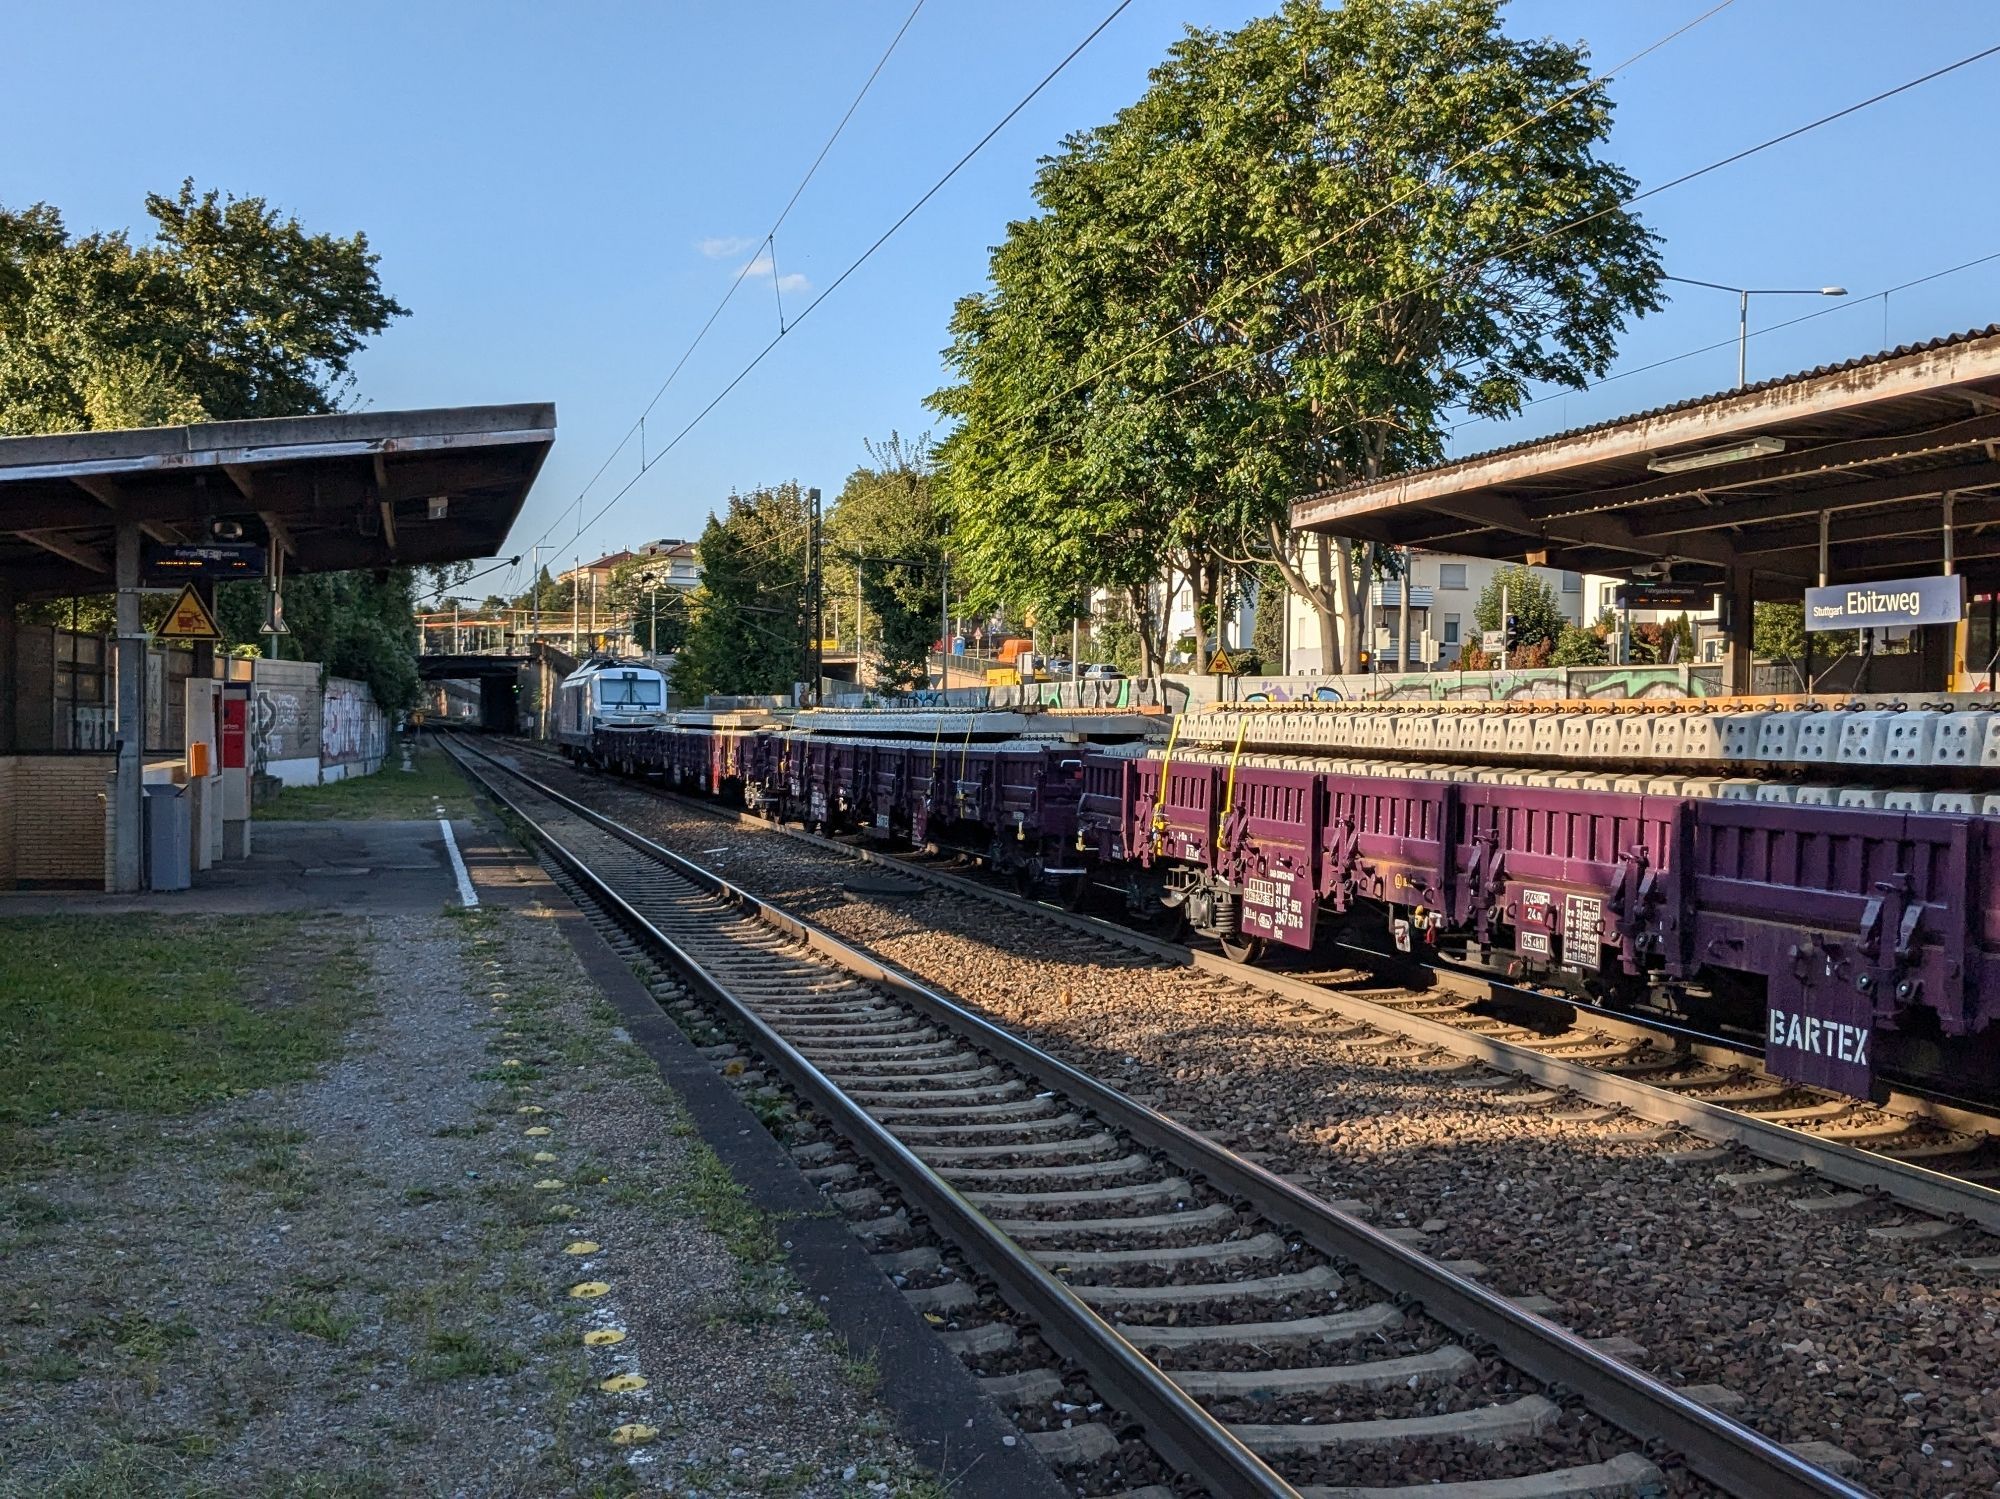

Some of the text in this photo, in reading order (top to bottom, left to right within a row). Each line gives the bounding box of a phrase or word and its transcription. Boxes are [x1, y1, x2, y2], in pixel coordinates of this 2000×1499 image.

[1813, 590, 1920, 619] Stuttgart Ebitzweg
[1769, 1008, 1869, 1066] BARTEX
